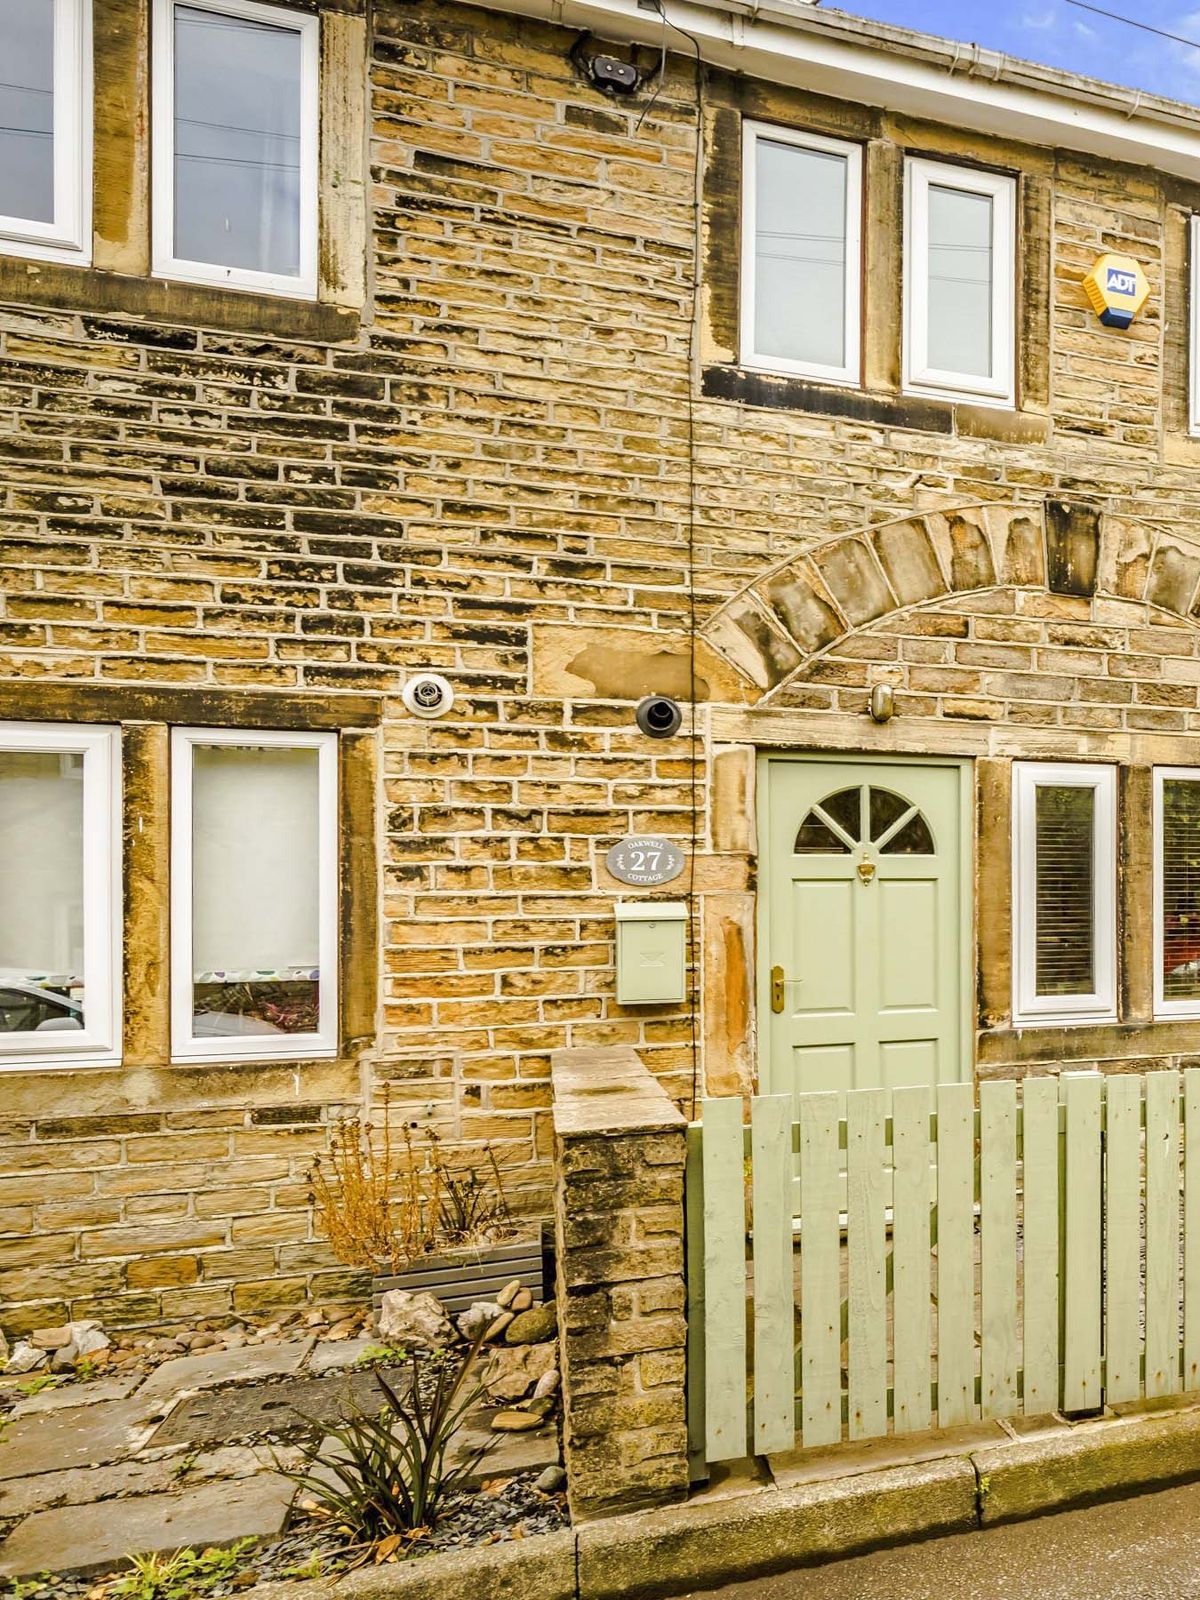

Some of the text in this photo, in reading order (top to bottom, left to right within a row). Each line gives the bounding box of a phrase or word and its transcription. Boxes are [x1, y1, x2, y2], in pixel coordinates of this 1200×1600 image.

[1107, 273, 1135, 293] ADT
[630, 851, 661, 871] 27
[628, 873, 663, 882] COTTAGE
